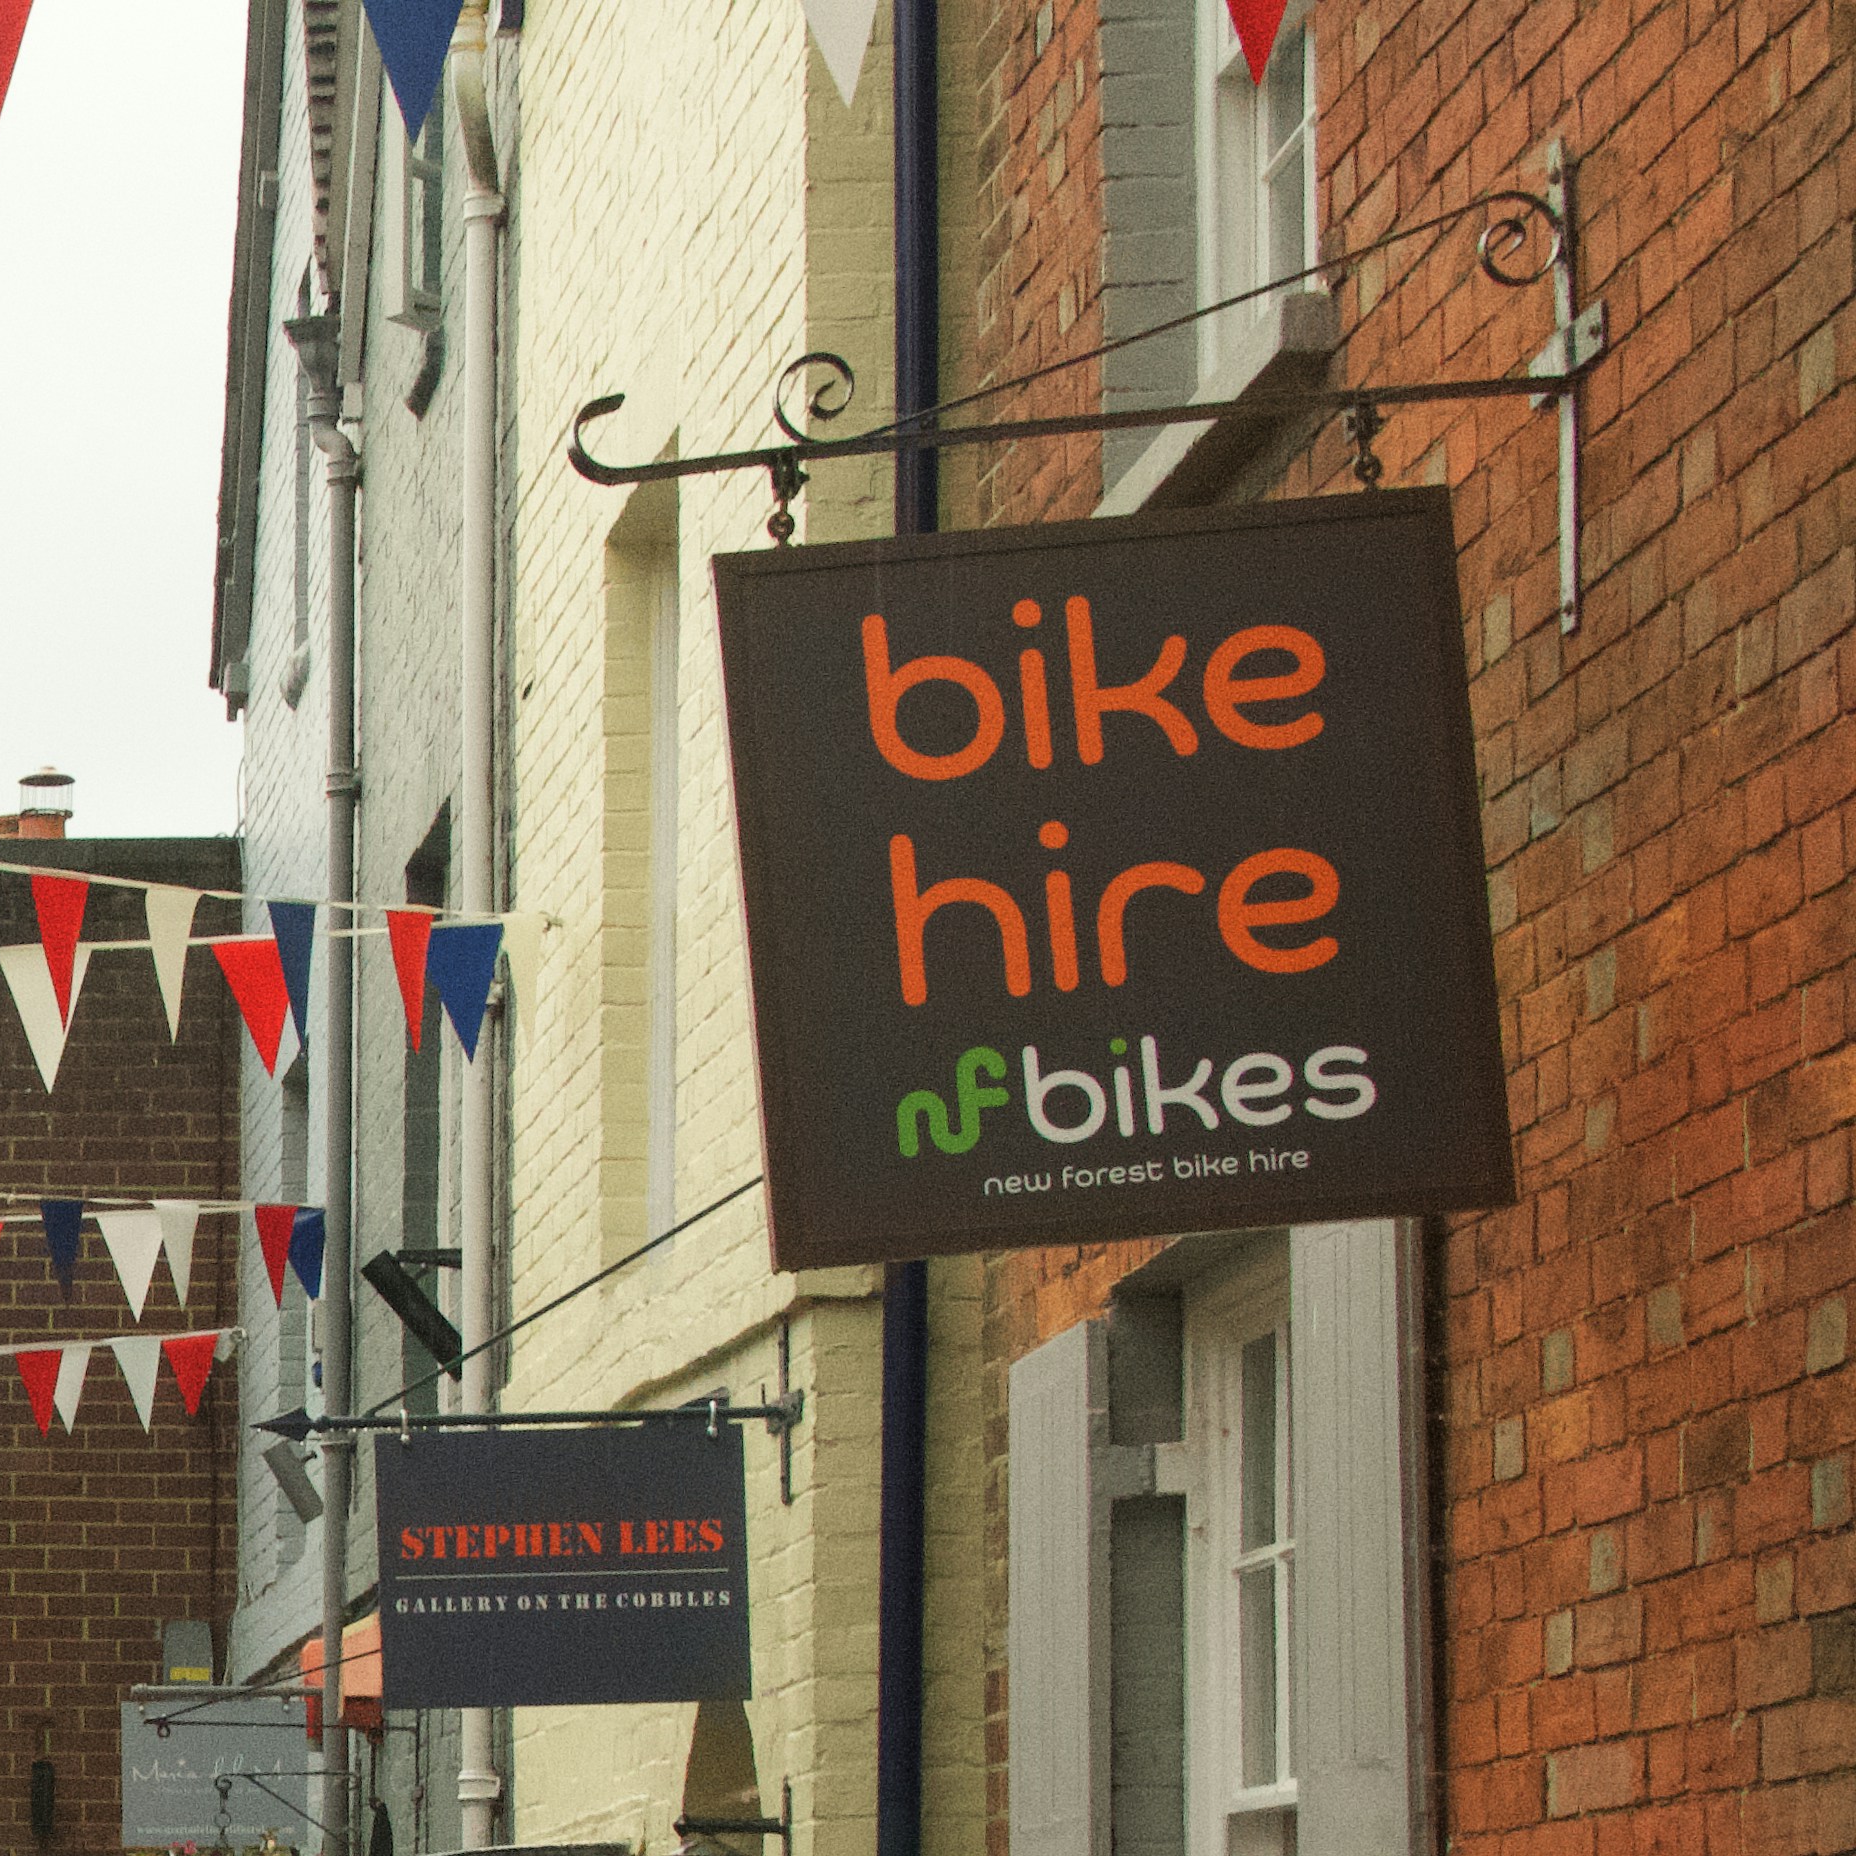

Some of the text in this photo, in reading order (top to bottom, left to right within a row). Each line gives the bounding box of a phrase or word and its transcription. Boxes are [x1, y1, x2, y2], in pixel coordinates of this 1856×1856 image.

[862, 596, 1326, 780] bike
[890, 821, 1340, 1006] hire
[983, 1149, 1309, 1196] new forest bike hire
[401, 1519, 725, 1560] STEPHEN LEES
[395, 1589, 731, 1614] GALLERY ON THE COBBLES
